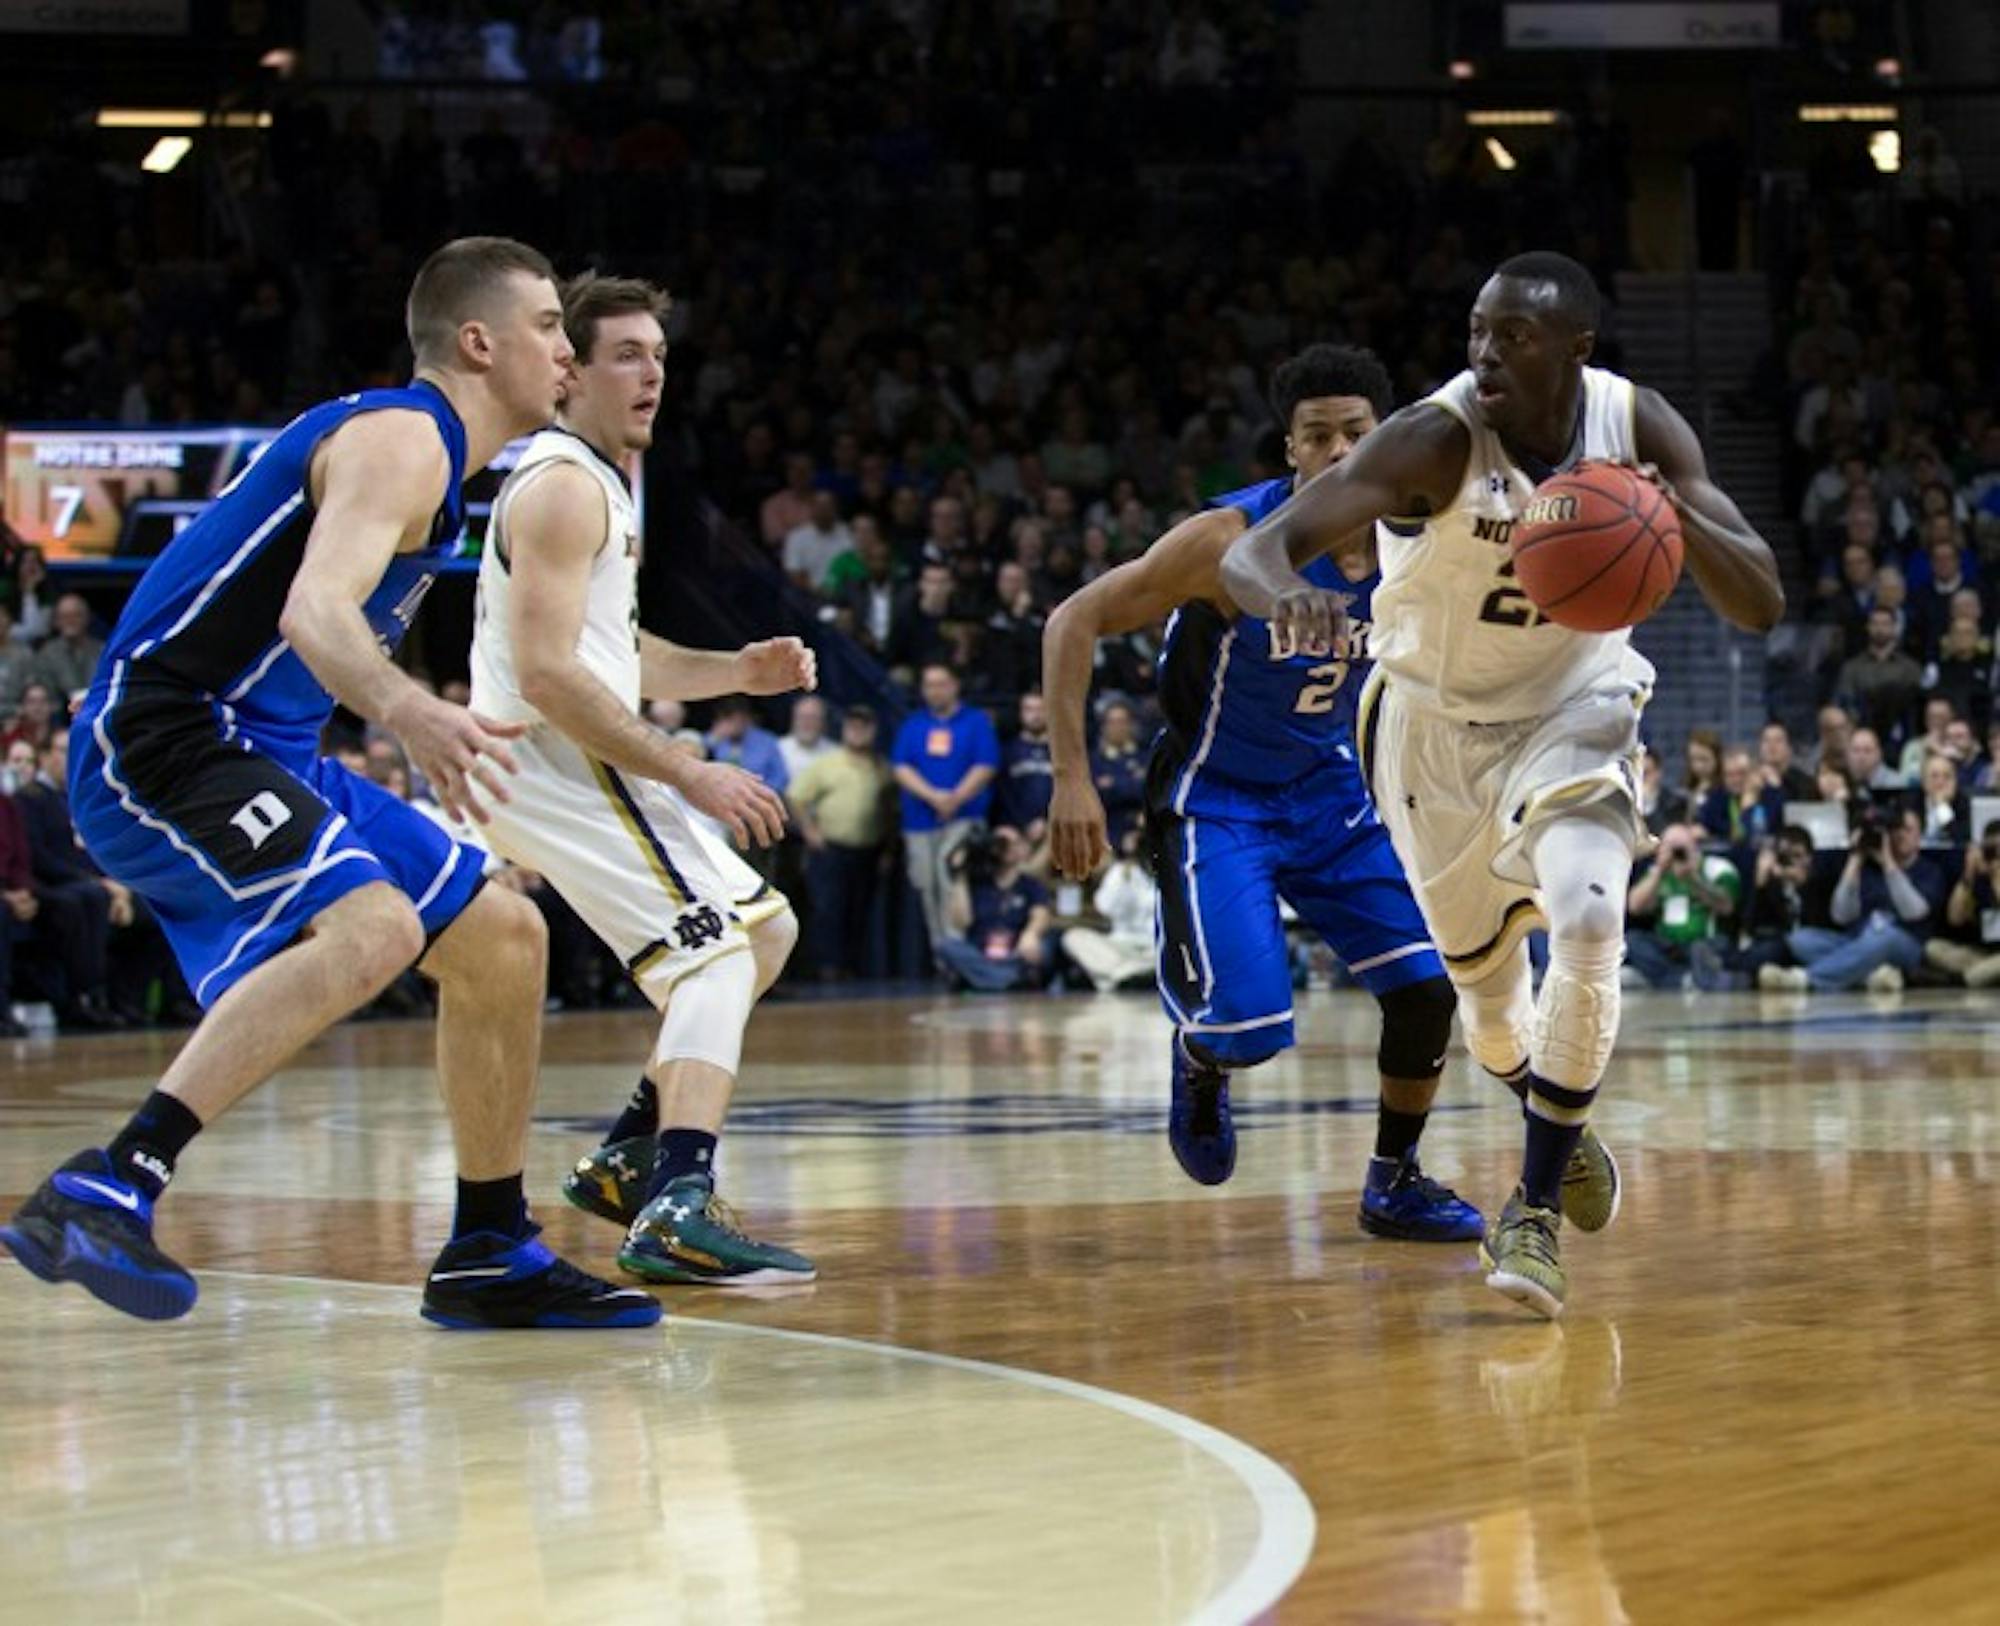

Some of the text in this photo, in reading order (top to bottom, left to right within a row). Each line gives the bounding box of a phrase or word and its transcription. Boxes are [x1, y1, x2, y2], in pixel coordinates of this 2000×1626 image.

[34, 445, 183, 467] NOTRE DAME
[50, 485, 84, 538] 7
[1472, 517, 1517, 543] NO
[1479, 559, 1551, 627] 2
[1294, 661, 1349, 714] 2
[229, 790, 292, 850] D
